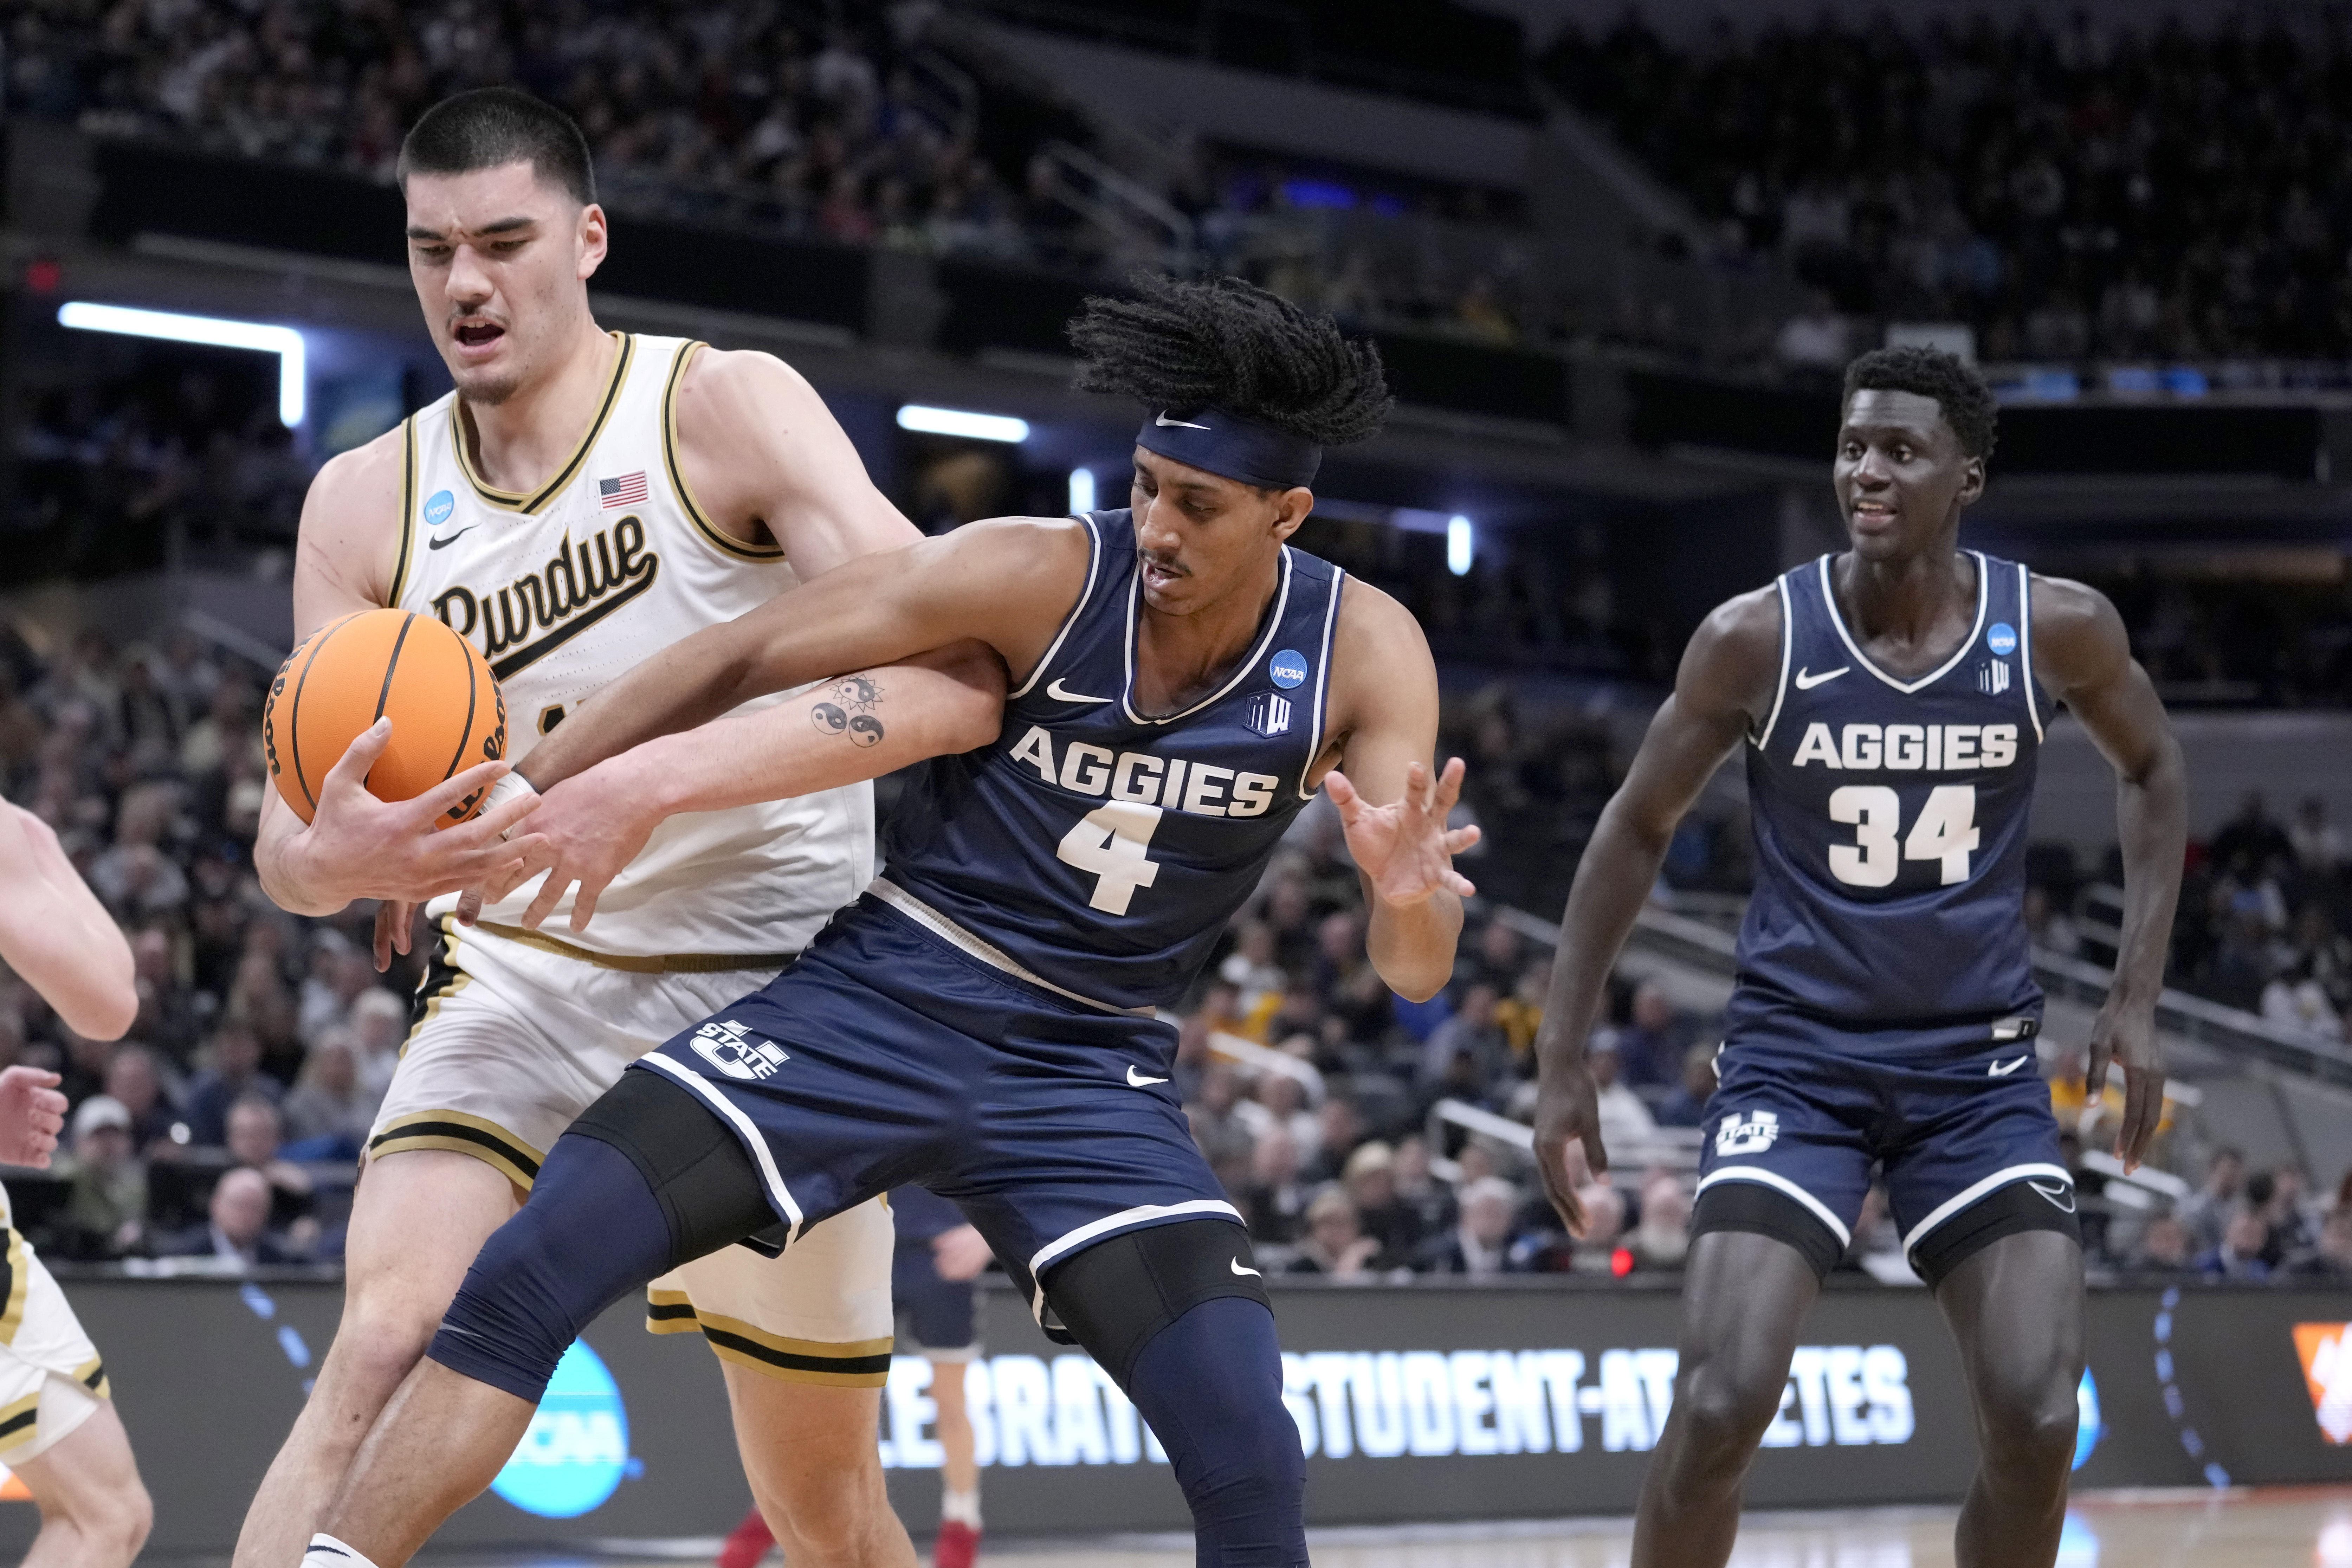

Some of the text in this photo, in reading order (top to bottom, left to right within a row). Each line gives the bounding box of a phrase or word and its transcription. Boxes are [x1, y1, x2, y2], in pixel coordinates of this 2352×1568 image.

[428, 502, 452, 518] NCAA
[429, 515, 660, 662] Purdue
[1273, 666, 1304, 681] NCAA
[1009, 725, 1279, 817] AGGIES
[1792, 722, 2018, 770] AGGIES
[1056, 799, 1164, 916] 4
[1828, 784, 1980, 888] 34
[696, 1023, 778, 1080] STATE
